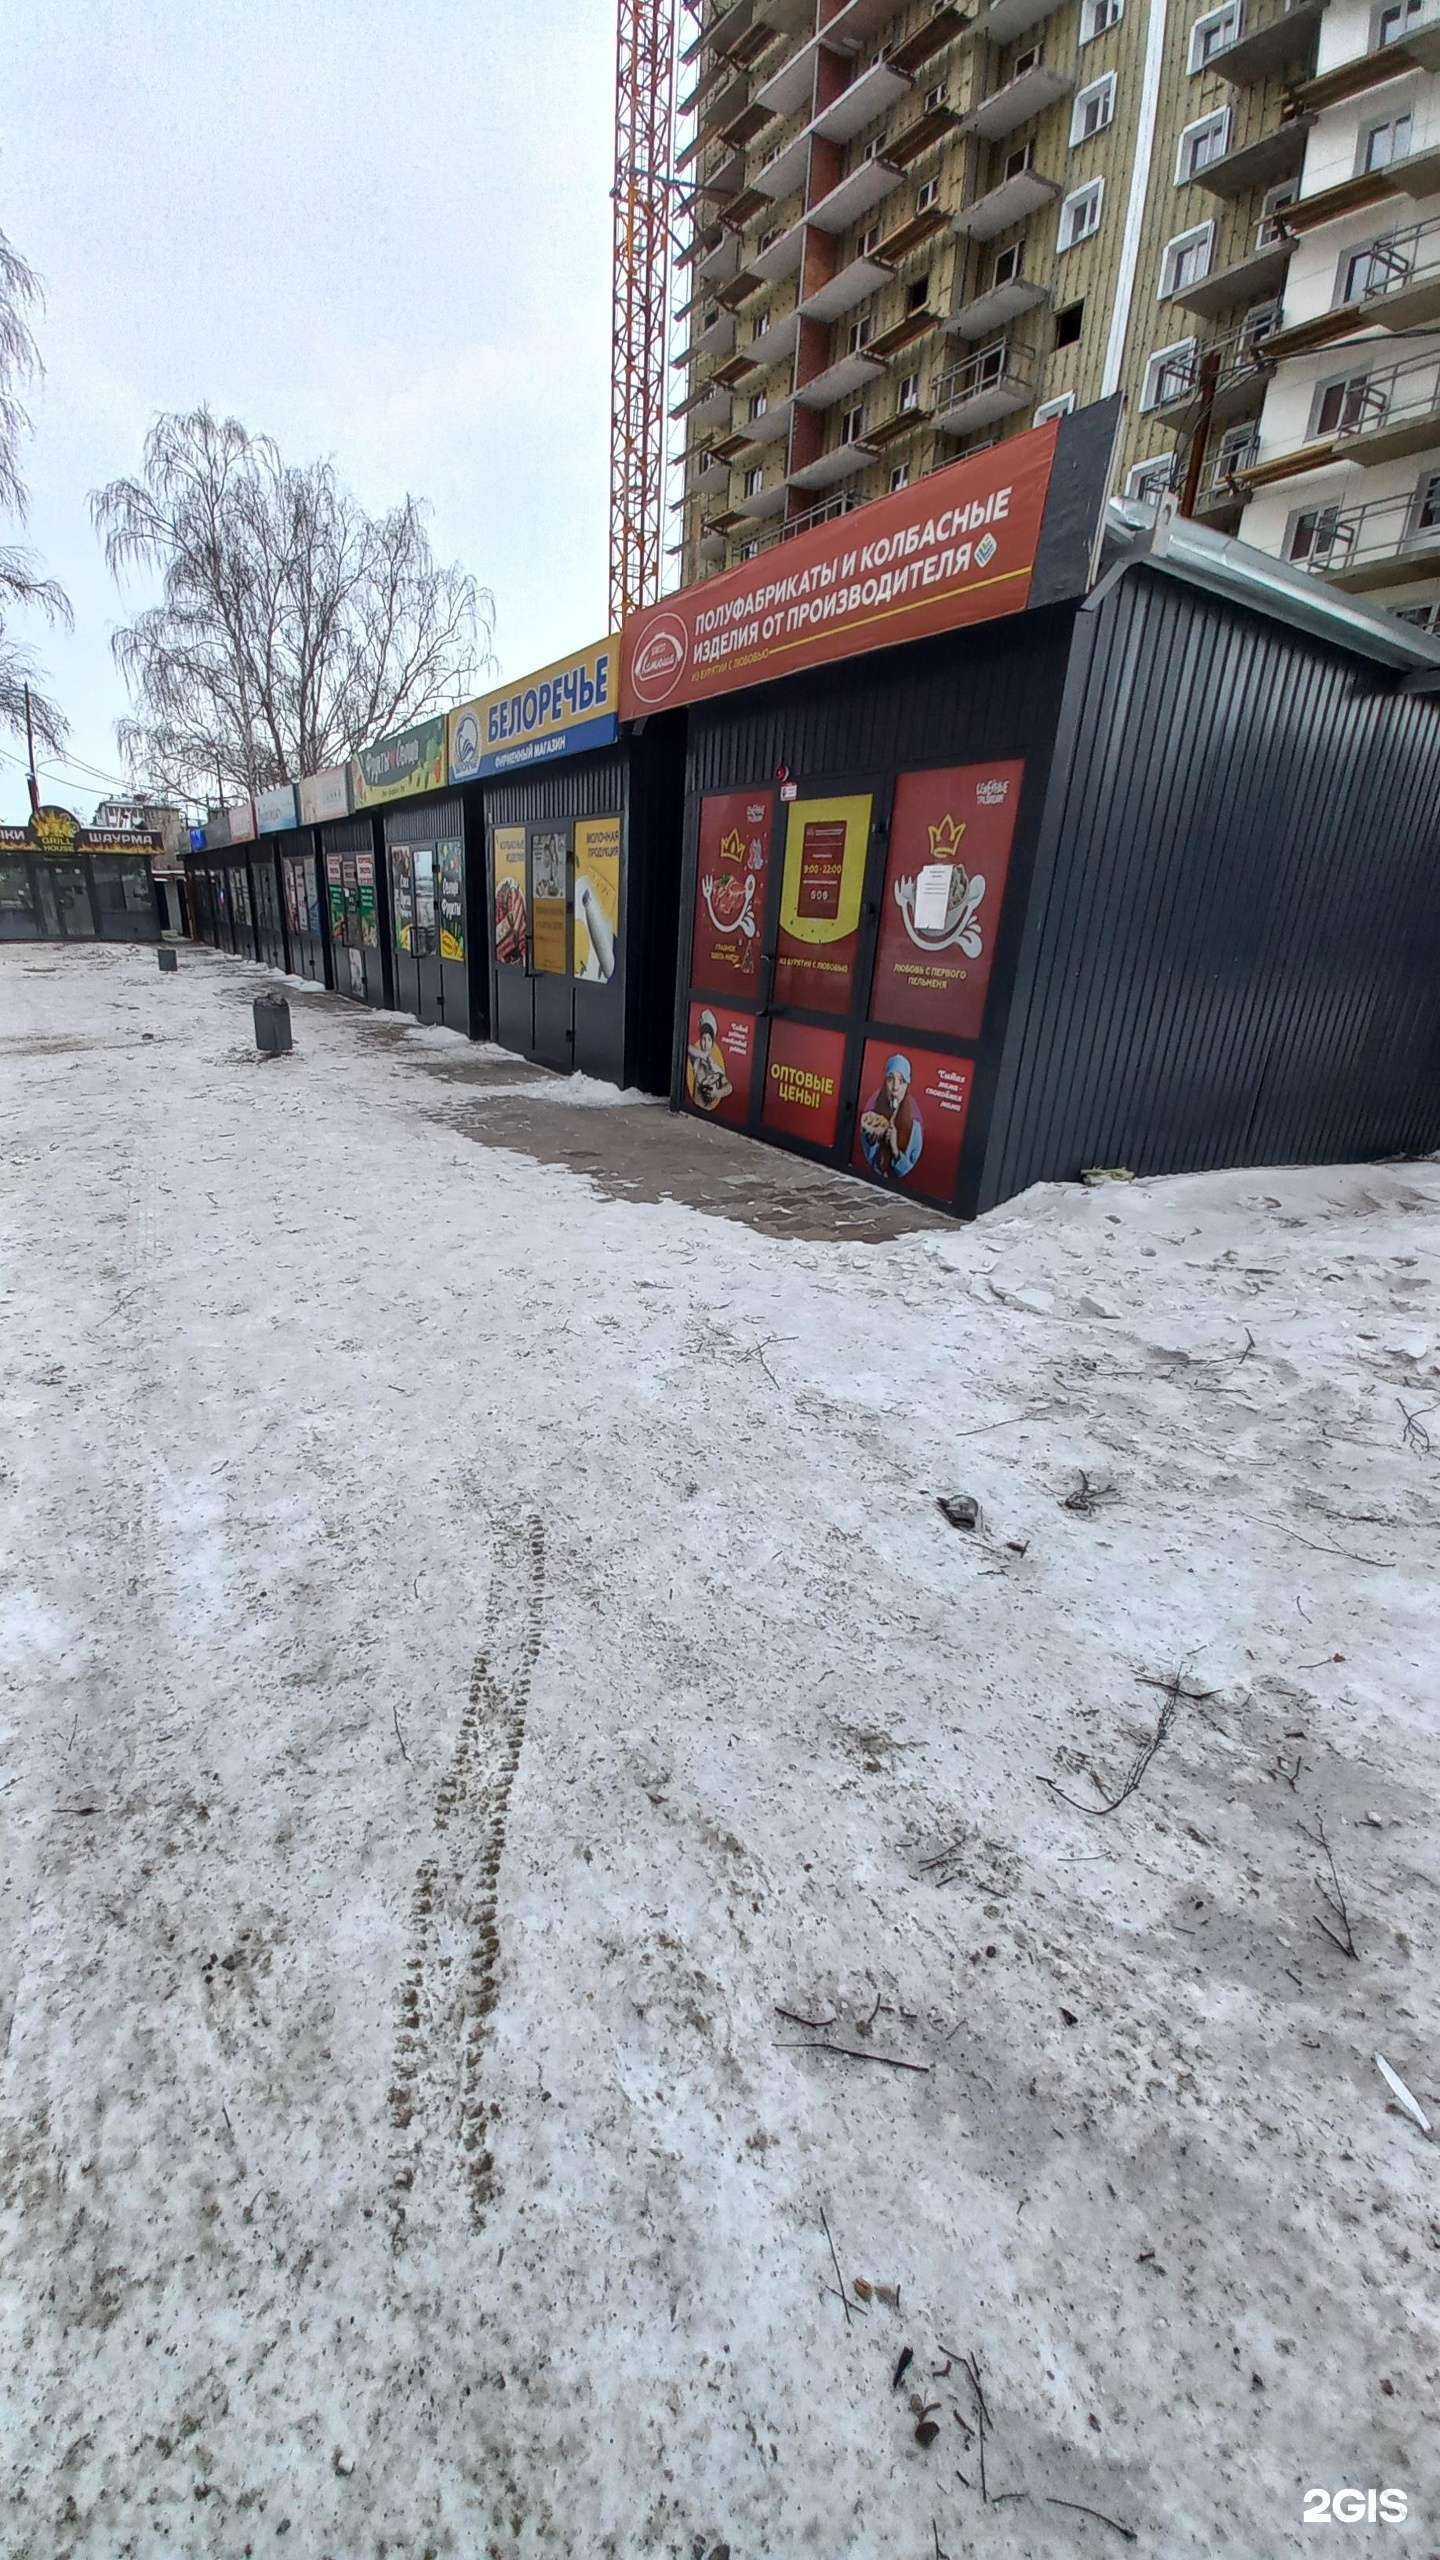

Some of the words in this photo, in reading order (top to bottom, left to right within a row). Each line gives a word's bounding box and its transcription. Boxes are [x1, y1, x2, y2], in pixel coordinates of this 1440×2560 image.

[694, 558, 838, 637] ПОЛУФАБРИКАТЫ
[841, 551, 857, 579] И
[860, 486, 1013, 572] КОЛБАСНЫЕ
[692, 620, 760, 665] ИЗДЕЛИЯ
[762, 610, 785, 640] ОТ
[786, 542, 973, 632] ПРОИЗВОДИТЕЛЯ
[488, 654, 609, 743] БЕЛОРЕЧЬЕ
[533, 736, 566, 760] МАГАЗИН
[88, 833, 153, 845] ШАУРМА
[770, 1063, 834, 1095] ОПТОВЫЕ
[779, 1082, 821, 1108] ЦЕНЫ!
